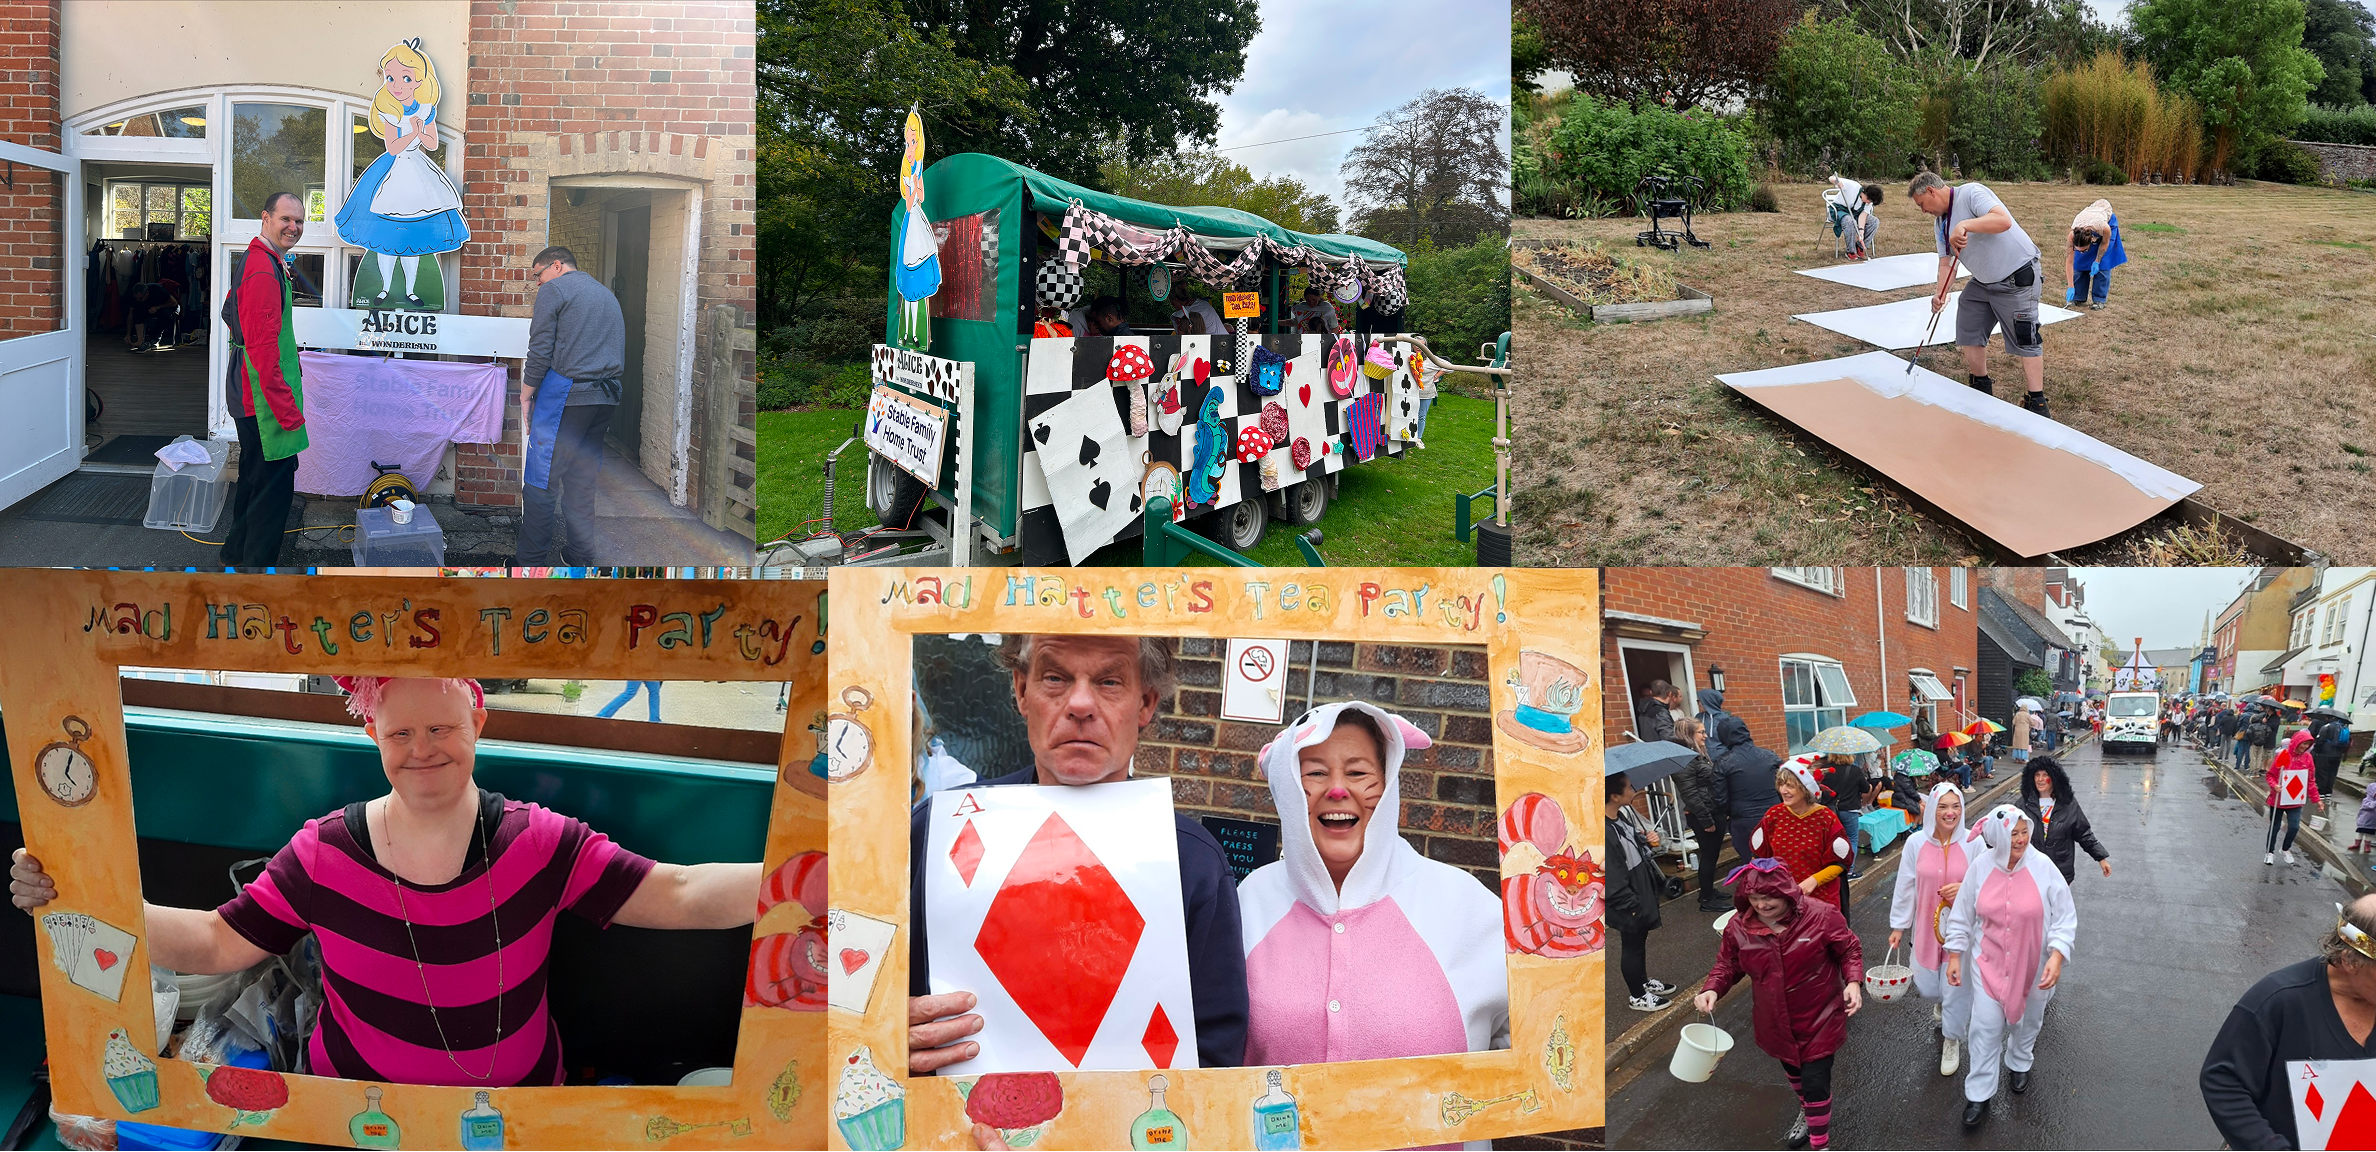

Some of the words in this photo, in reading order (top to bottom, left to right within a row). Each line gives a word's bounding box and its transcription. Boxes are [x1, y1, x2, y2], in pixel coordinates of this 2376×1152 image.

[362, 309, 437, 335] ALICE
[371, 340, 438, 351] WONDERLAND
[897, 350, 923, 375] ALICE
[887, 404, 910, 429] Stable
[910, 416, 937, 449] Family
[882, 424, 905, 451] Home
[907, 437, 927, 465] Trust
[1004, 572, 1214, 619] Hatter's
[1245, 581, 1330, 620] Tea
[205, 597, 440, 656] Hatter's
[478, 607, 588, 656] Tea
[952, 792, 985, 817] A
[1220, 827, 1258, 839] PLEASE
[1223, 840, 1253, 851] PRESS
[1232, 852, 1254, 863] YOU
[2301, 1063, 2319, 1080] A
